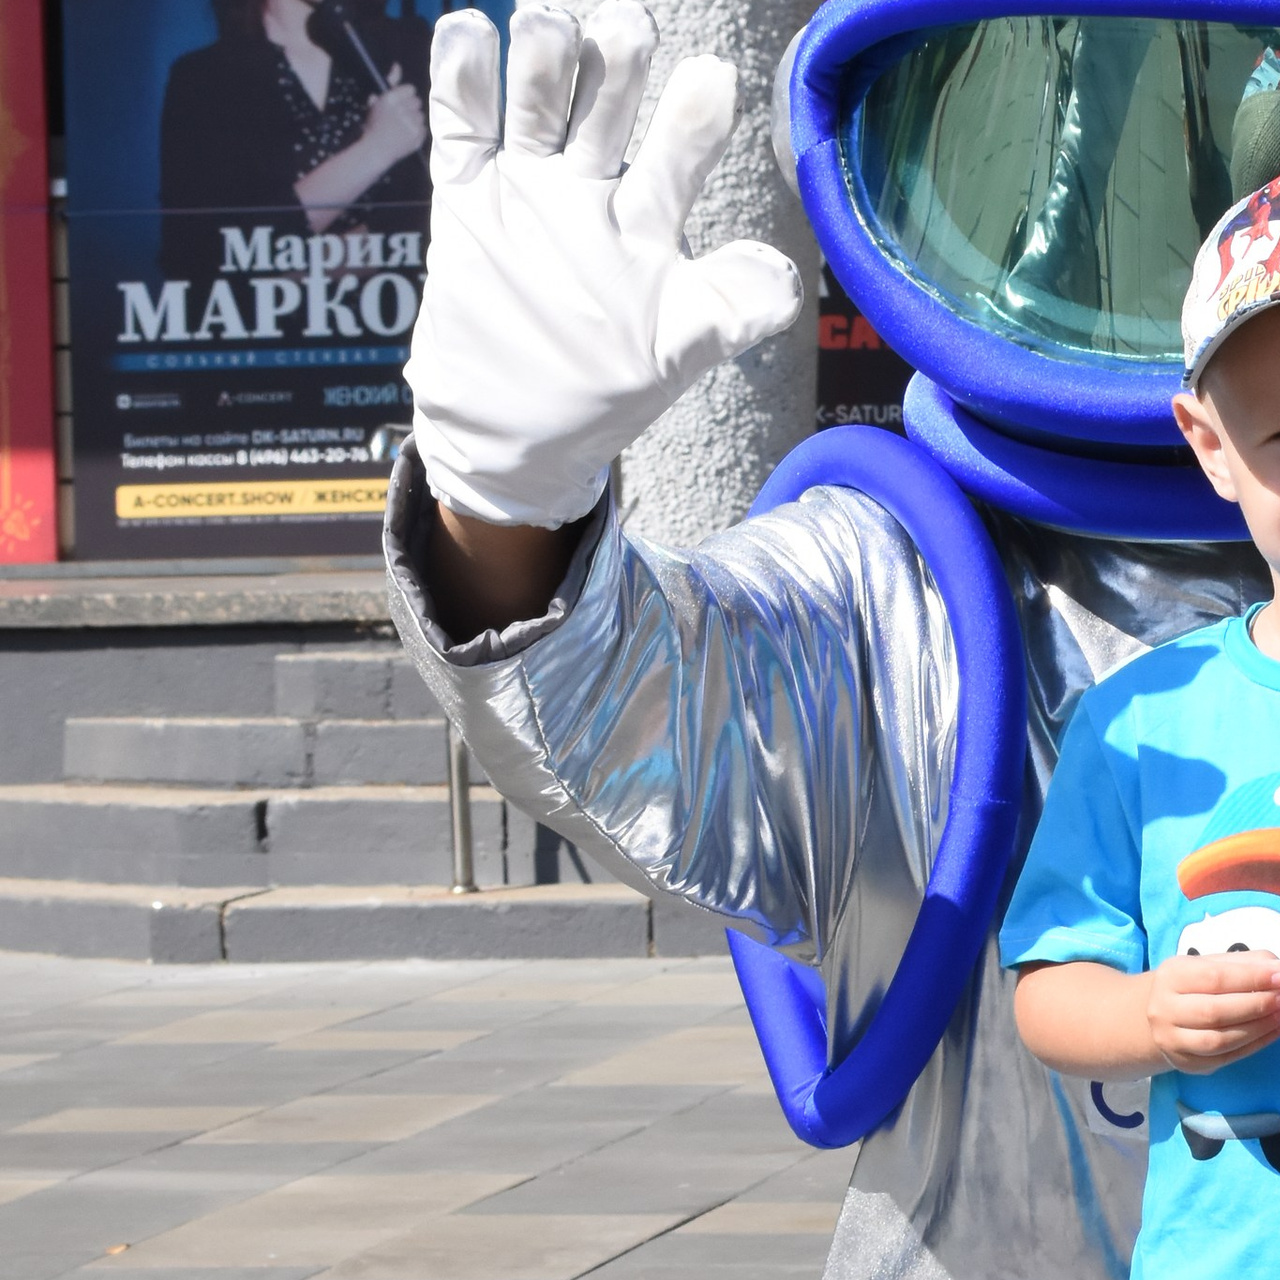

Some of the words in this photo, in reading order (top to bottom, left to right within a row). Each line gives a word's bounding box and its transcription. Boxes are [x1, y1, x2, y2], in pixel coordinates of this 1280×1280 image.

[219, 226, 422, 282] Мария
[117, 272, 427, 343] МАРКО
[313, 489, 387, 505] ЖЕНСКИ
